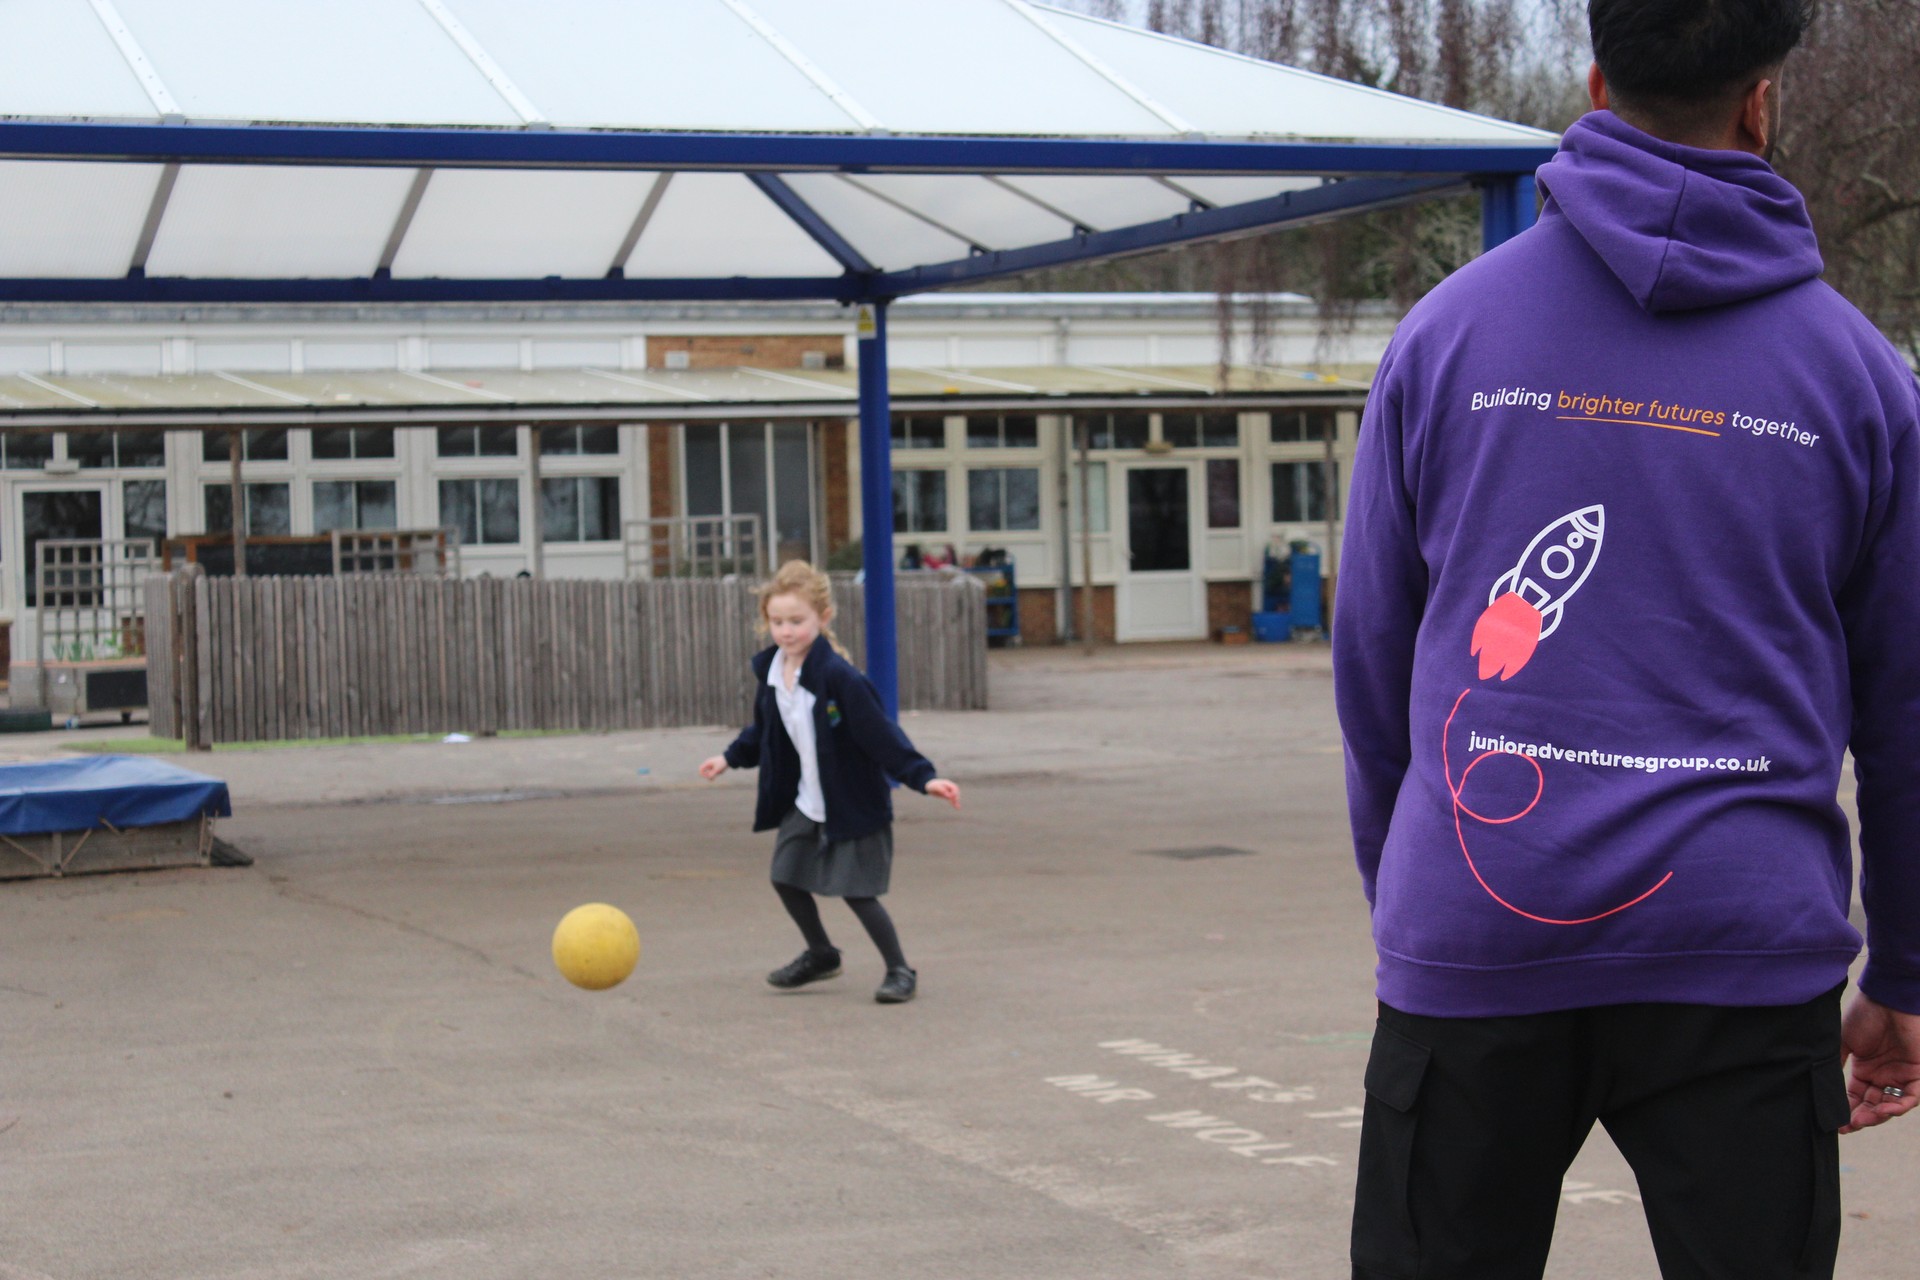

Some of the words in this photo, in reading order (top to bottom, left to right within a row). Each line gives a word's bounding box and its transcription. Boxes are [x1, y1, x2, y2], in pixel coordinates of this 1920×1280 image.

[1470, 386, 1552, 411] Building
[1556, 390, 1644, 416] brighter
[1648, 400, 1726, 426] futures
[1731, 410, 1820, 449] together
[1467, 730, 1772, 774] junioradventuresgroup.co.uk
[1044, 1074, 1156, 1103] MR
[1145, 1110, 1339, 1167] WOLF
